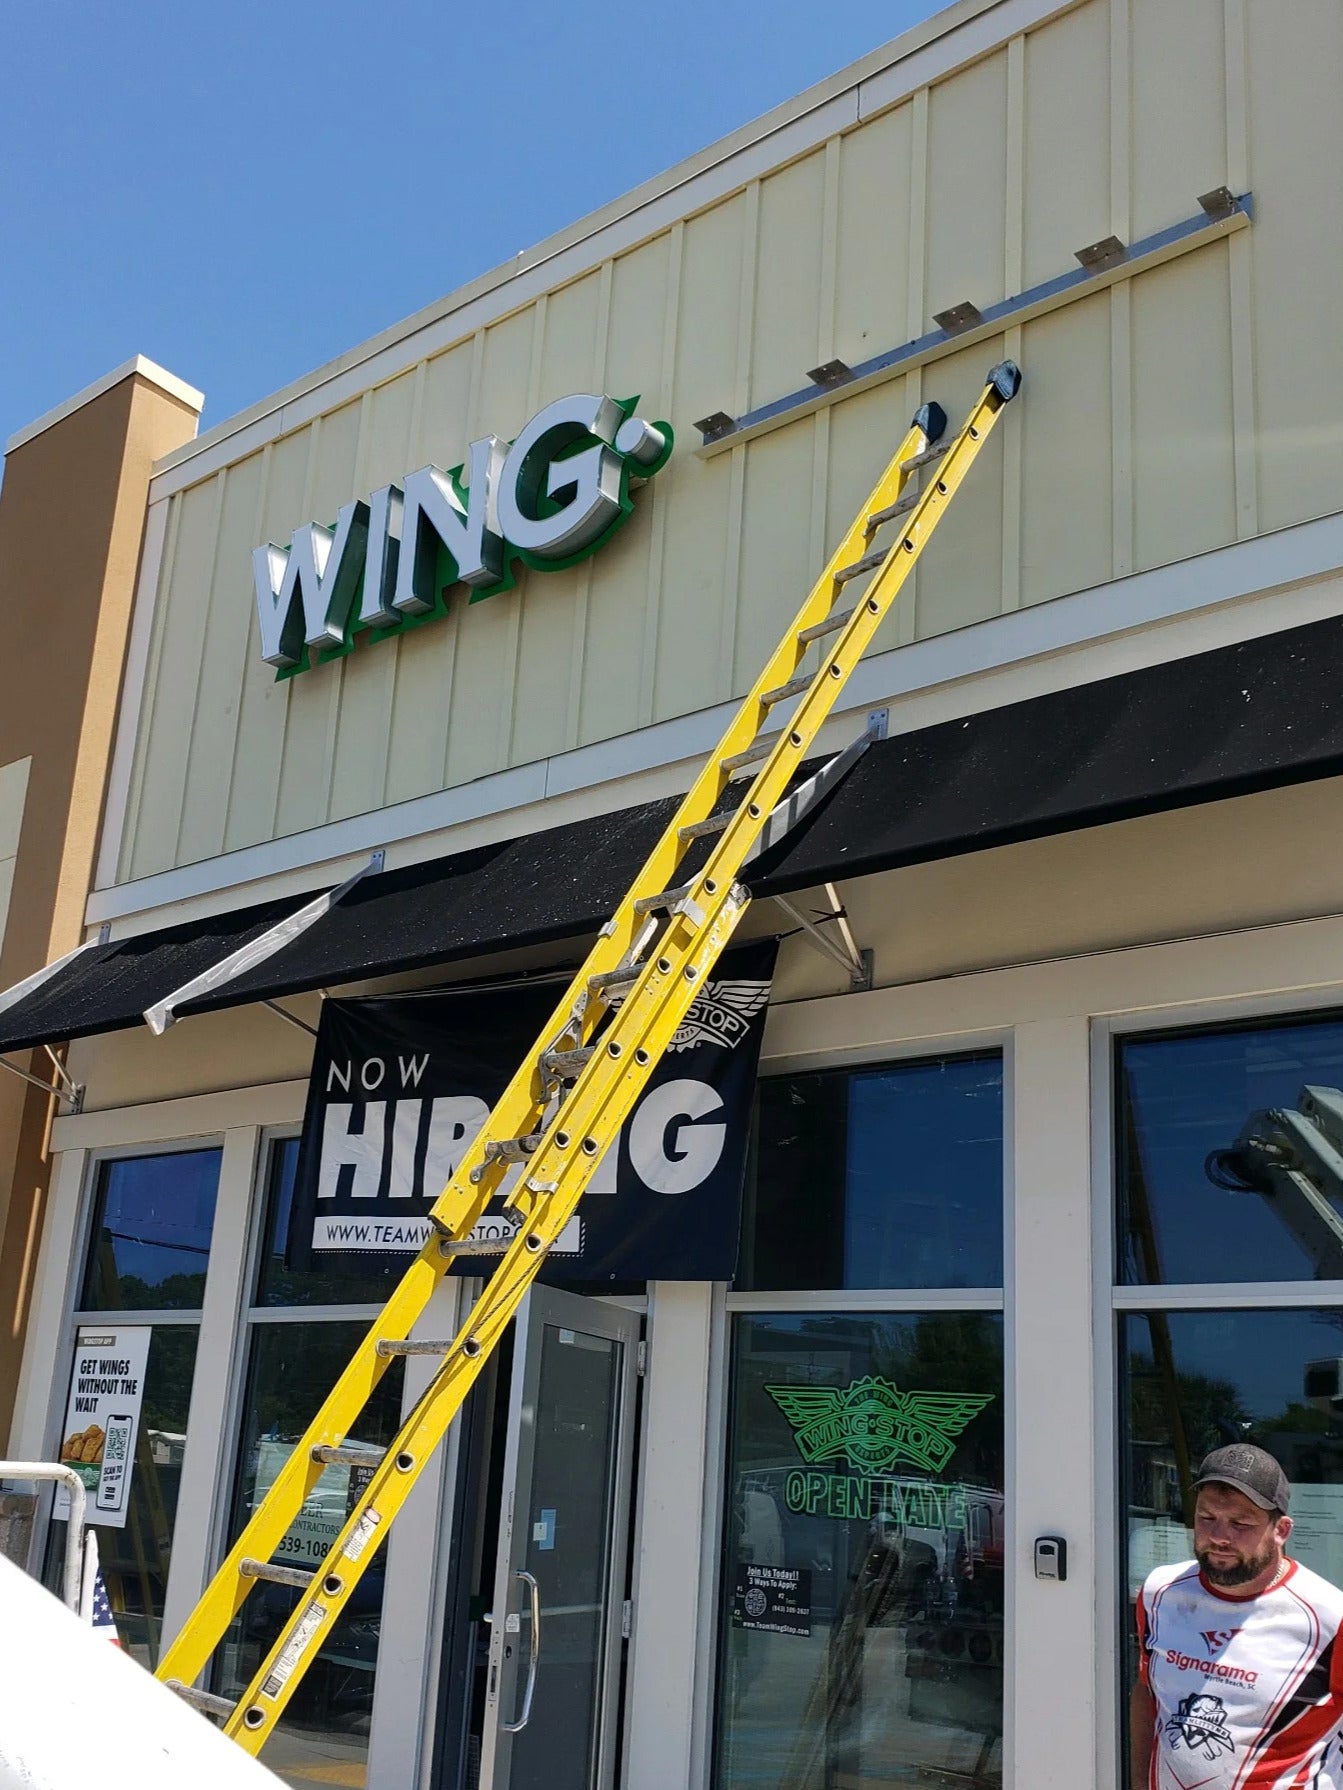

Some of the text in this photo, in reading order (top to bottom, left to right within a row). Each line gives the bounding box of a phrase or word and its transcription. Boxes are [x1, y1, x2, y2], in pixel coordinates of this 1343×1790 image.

[252, 393, 637, 682] WING
[326, 1053, 430, 1092] NOW
[317, 1078, 728, 1199] HIRG
[80, 1359, 131, 1376] GET WINGS
[78, 1378, 138, 1396] WITHOUT THE
[75, 1396, 99, 1414] WAIT
[803, 1413, 946, 1459] WING STOP
[116, 1465, 123, 1474] TO
[785, 1471, 967, 1530] OPEN LATE
[291, 1519, 341, 1536] ONTRACTORS
[747, 1566, 761, 1576] Join
[762, 1567, 772, 1577] Us
[748, 1577, 753, 1585] 3
[754, 1578, 770, 1588] Ways
[770, 1579, 777, 1587] To
[1166, 1649, 1259, 1683] Signarama
[1204, 1673, 1256, 1691] Myrtle Beach, SC
